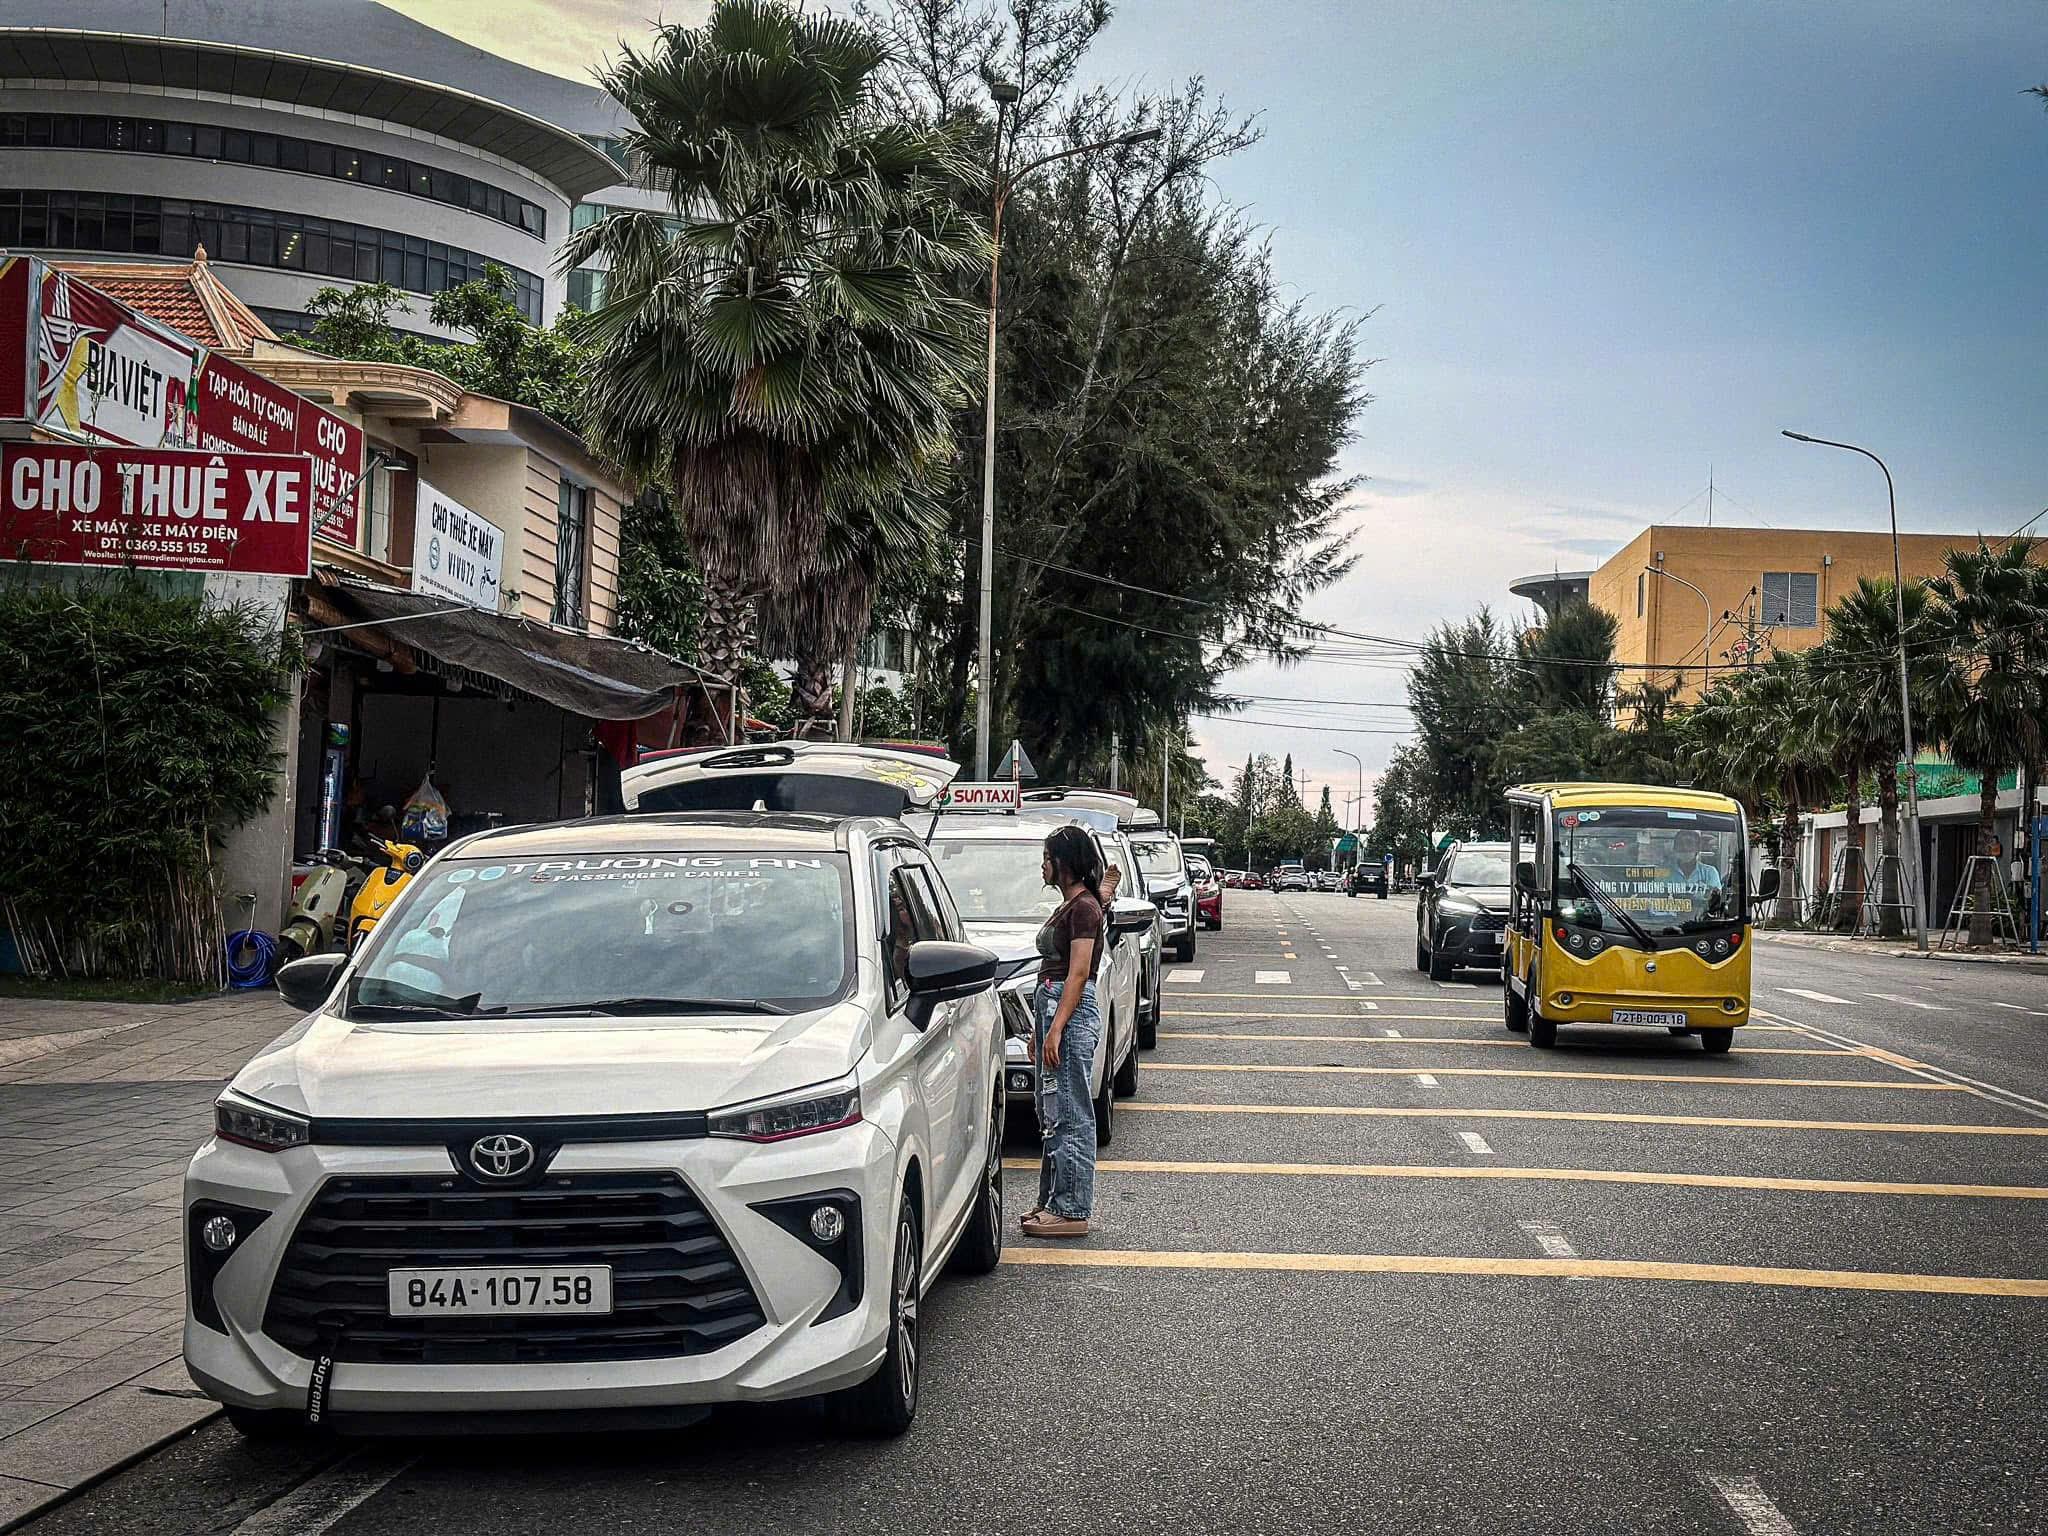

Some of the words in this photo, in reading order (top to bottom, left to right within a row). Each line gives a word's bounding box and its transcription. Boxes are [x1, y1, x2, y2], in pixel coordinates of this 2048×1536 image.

[208, 370, 228, 399] TẠP
[229, 381, 250, 410] HÓA
[252, 394, 267, 421] TỰ
[267, 400, 293, 431] CHỌN
[232, 415, 248, 436] BÁN
[248, 423, 258, 441] ĐÁ
[318, 416, 346, 455] CHO
[12, 457, 101, 513] CHO
[117, 457, 228, 520] THUÊ
[243, 469, 300, 523] XE
[338, 468, 355, 501] XE
[72, 520, 92, 532] XE
[96, 519, 128, 534] MÁY
[142, 523, 161, 536] XE
[166, 522, 198, 537] MÁY
[202, 525, 238, 542] ĐIỆN
[101, 538, 121, 549] ĐT:
[126, 540, 183, 553] 0369.555
[187, 542, 208, 554] 152
[432, 501, 448, 535] CHO
[449, 512, 467, 546] THUÊ
[467, 523, 479, 552] XE
[478, 527, 494, 561] MÁY
[552, 871, 676, 882] PASSENGER
[685, 870, 761, 879] CARIER
[749, 857, 822, 871] AN
[1620, 881, 1632, 893] TY
[408, 1276, 592, 1308] 84A-107.58
[310, 1355, 331, 1422] Supreme
